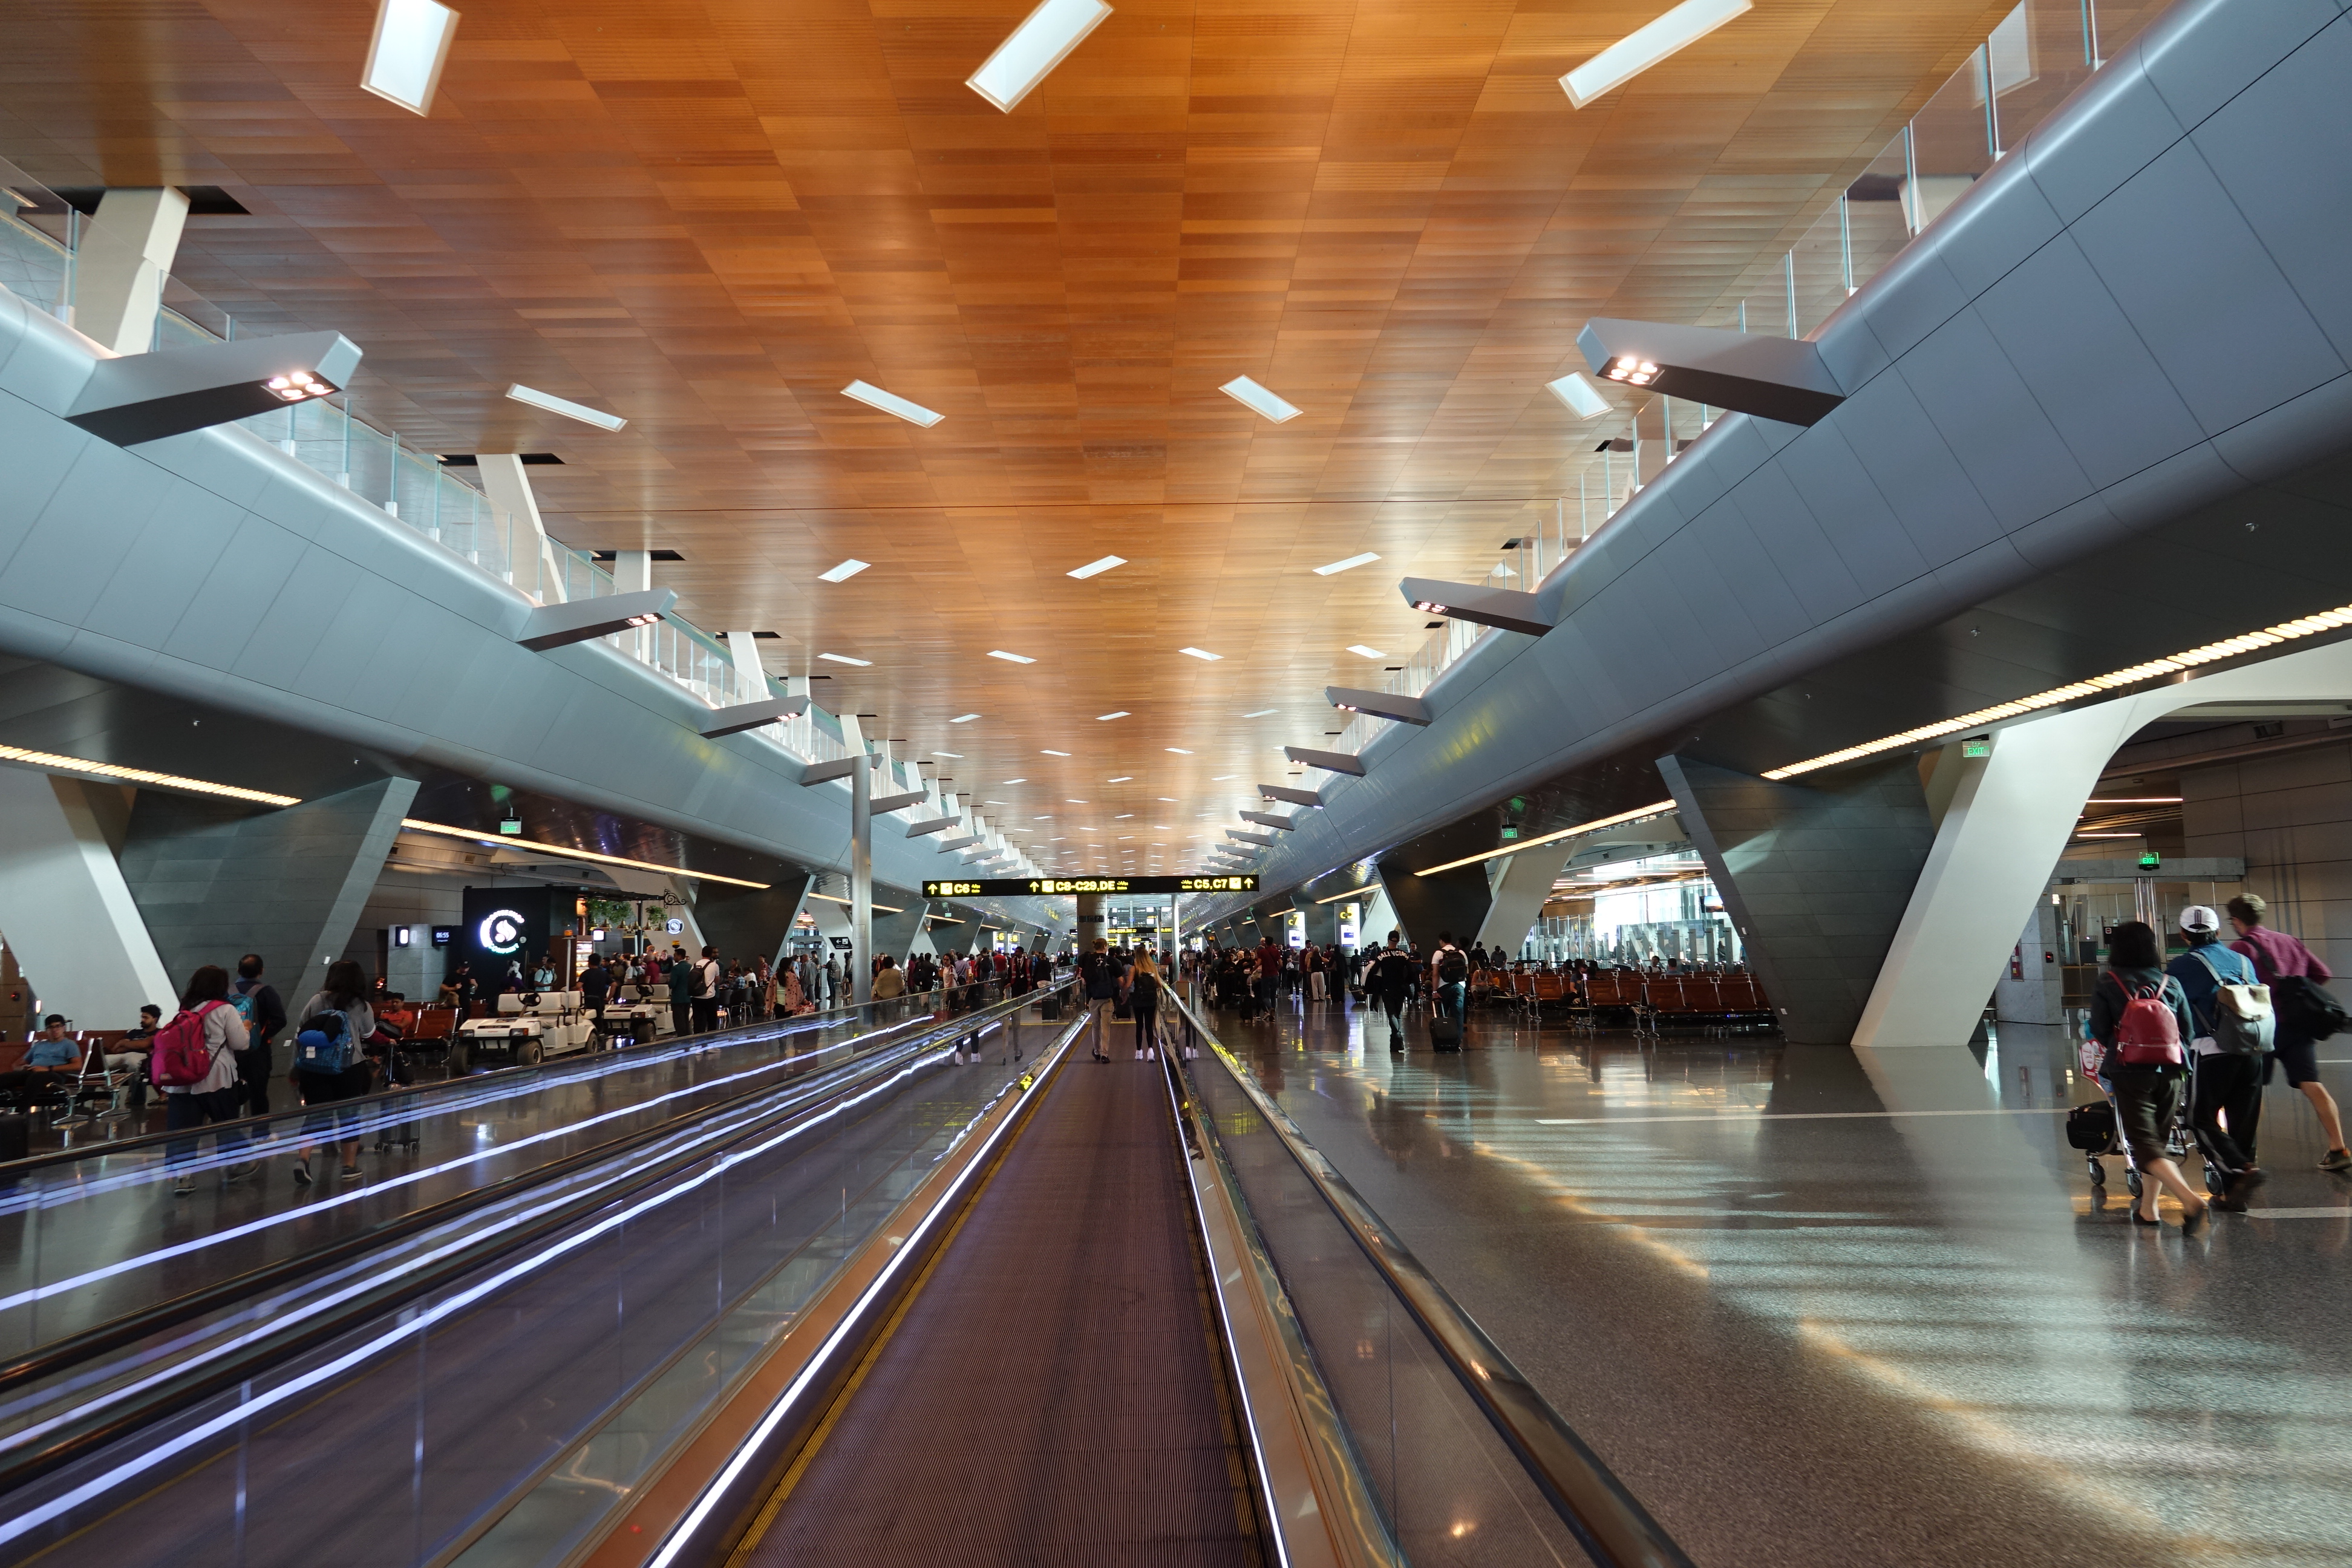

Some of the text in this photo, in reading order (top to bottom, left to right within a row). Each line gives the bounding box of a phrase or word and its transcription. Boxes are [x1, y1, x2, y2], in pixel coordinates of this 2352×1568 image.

[1967, 747, 1984, 756] EXIT
[953, 883, 970, 893] C6
[1056, 880, 1116, 892] C8-C29,DE
[1194, 878, 1227, 890] C5,C7
